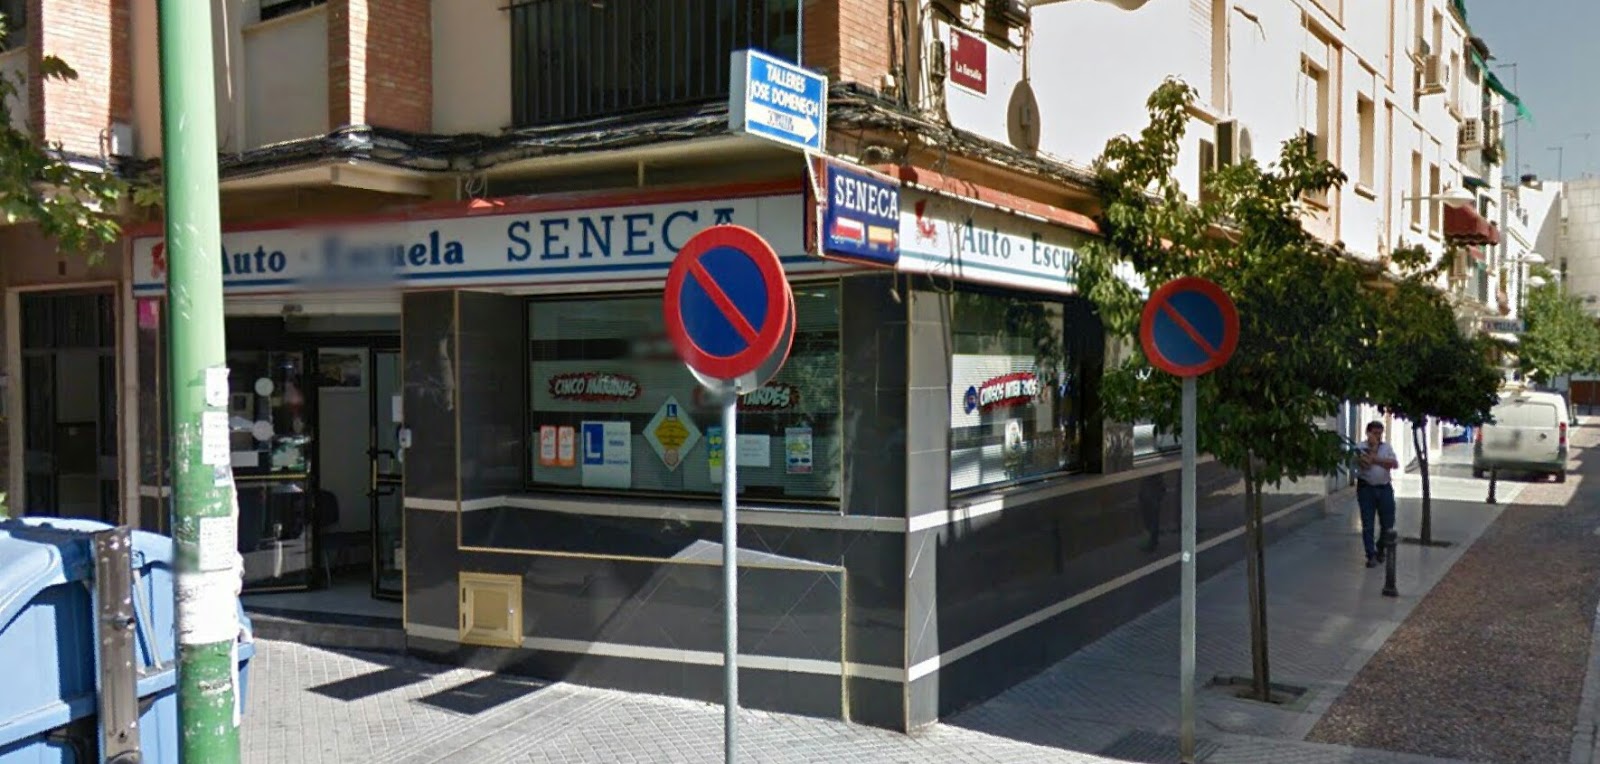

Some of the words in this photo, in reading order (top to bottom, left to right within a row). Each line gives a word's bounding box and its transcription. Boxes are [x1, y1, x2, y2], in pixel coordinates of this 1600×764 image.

[766, 63, 806, 93] TALLERES
[752, 80, 771, 101] JOSE
[772, 86, 819, 118] DOMENECH
[834, 174, 899, 220] SENECA
[962, 217, 1012, 259] Auto
[1031, 232, 1080, 271] Escue
[555, 377, 585, 396] CINCO
[586, 431, 601, 459] L
